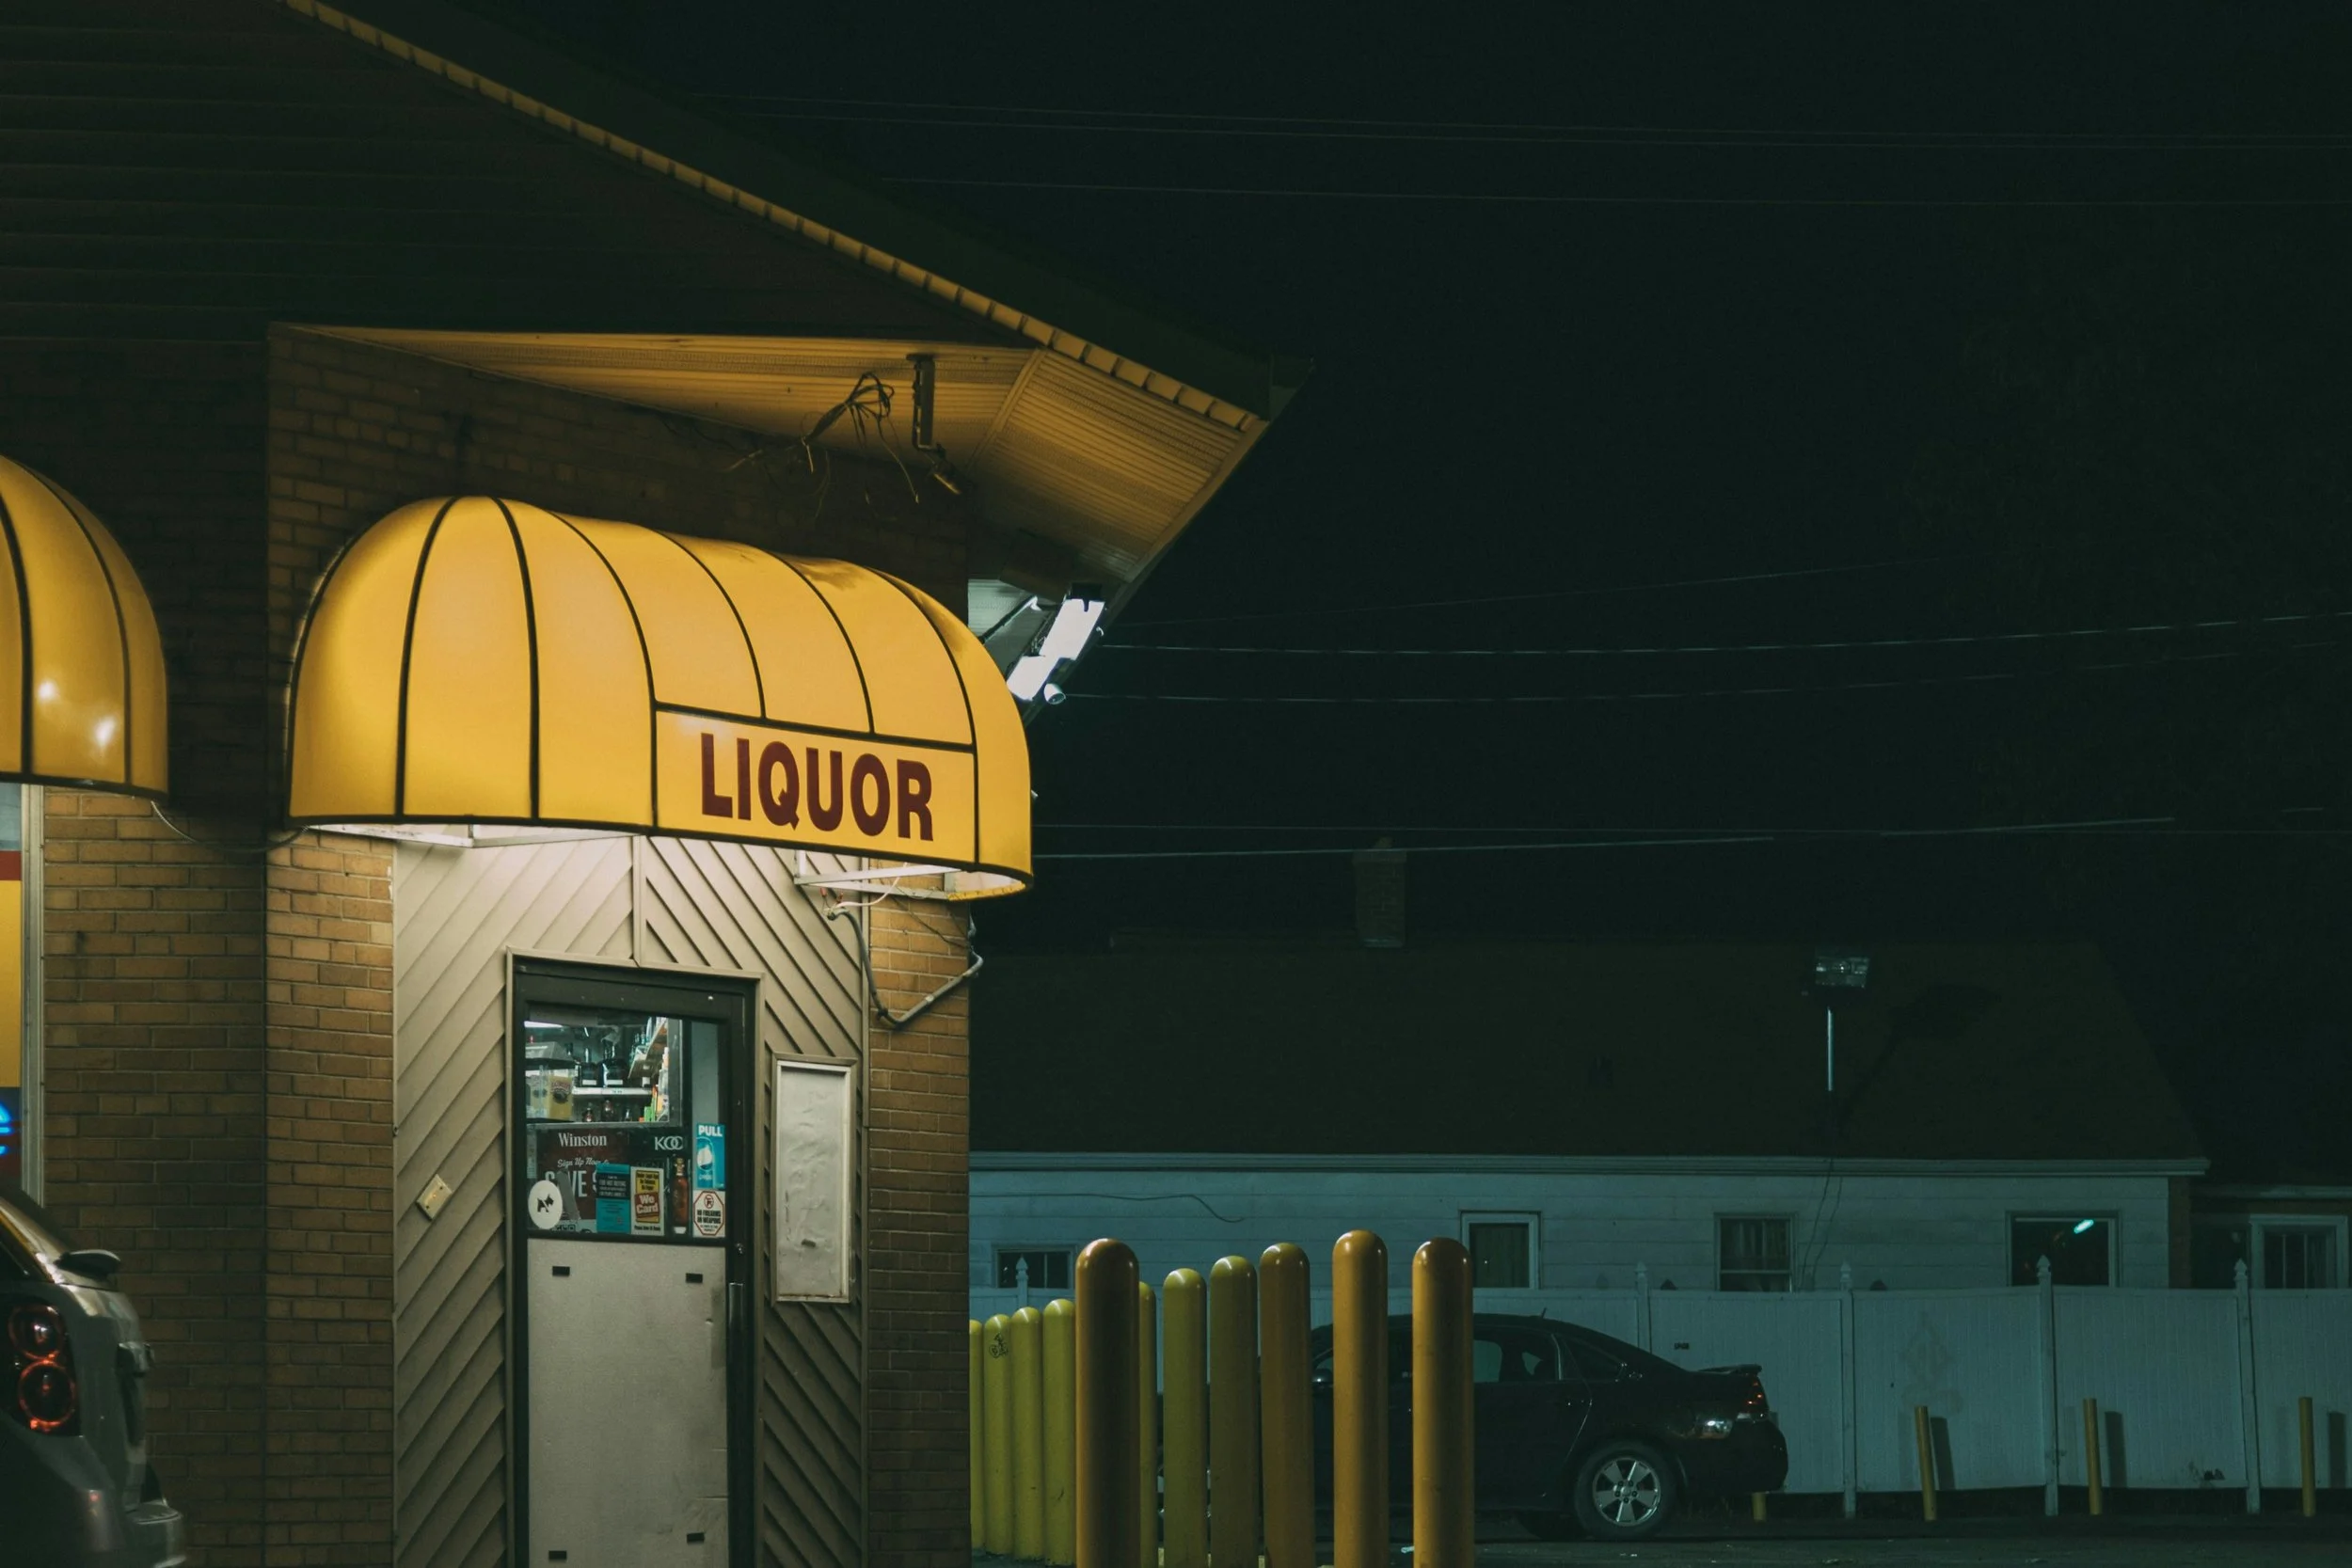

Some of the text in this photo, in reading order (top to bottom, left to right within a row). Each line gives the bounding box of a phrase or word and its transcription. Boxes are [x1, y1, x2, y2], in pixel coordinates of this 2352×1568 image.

[701, 733, 933, 842] LIQUOR
[698, 1125, 723, 1137] PULL
[558, 1132, 608, 1148] Winston
[557, 1159, 574, 1168] Sign
[639, 1194, 655, 1204] We
[636, 1203, 659, 1213] Card
